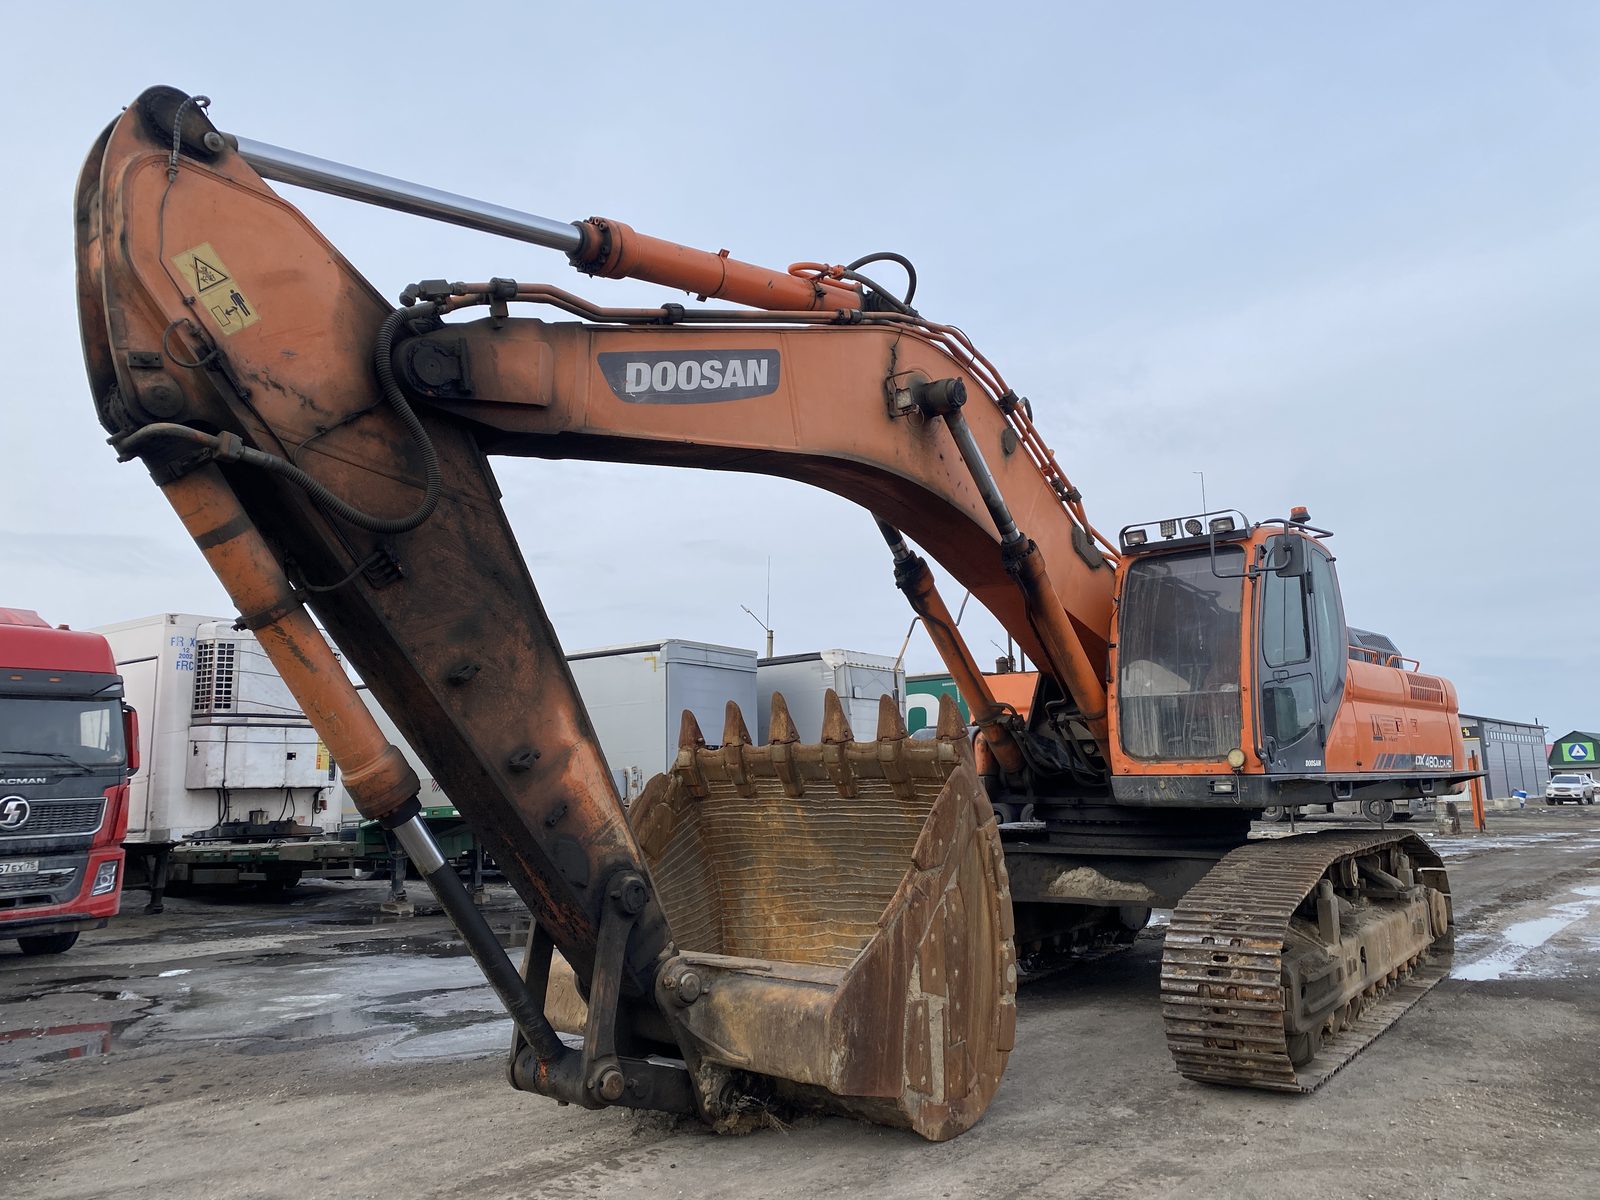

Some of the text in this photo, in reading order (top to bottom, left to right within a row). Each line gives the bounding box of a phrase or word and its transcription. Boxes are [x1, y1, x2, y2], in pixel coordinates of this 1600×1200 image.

[625, 359, 769, 393] DOOSAN
[176, 660, 194, 671] FRC
[1305, 759, 1321, 767] DOOSAN
